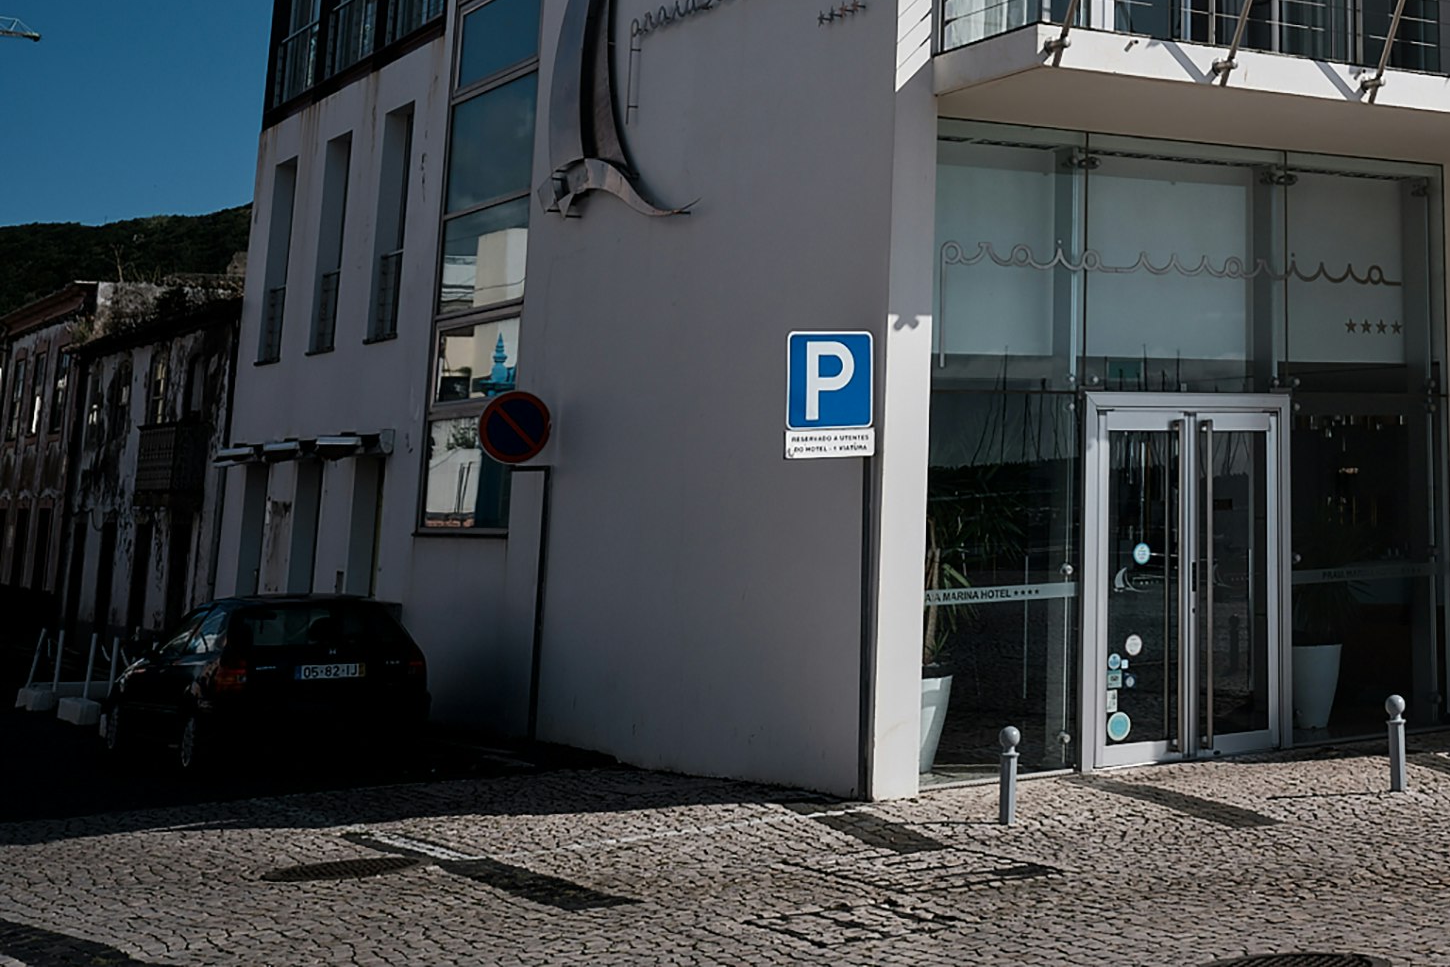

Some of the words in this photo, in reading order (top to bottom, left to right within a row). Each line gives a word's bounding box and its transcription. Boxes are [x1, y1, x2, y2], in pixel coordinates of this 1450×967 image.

[805, 341, 855, 421] P
[791, 435, 832, 443] RESERVADO
[793, 445, 804, 453] DO
[942, 591, 979, 602] MARINA
[981, 588, 1011, 599] HOTEL
